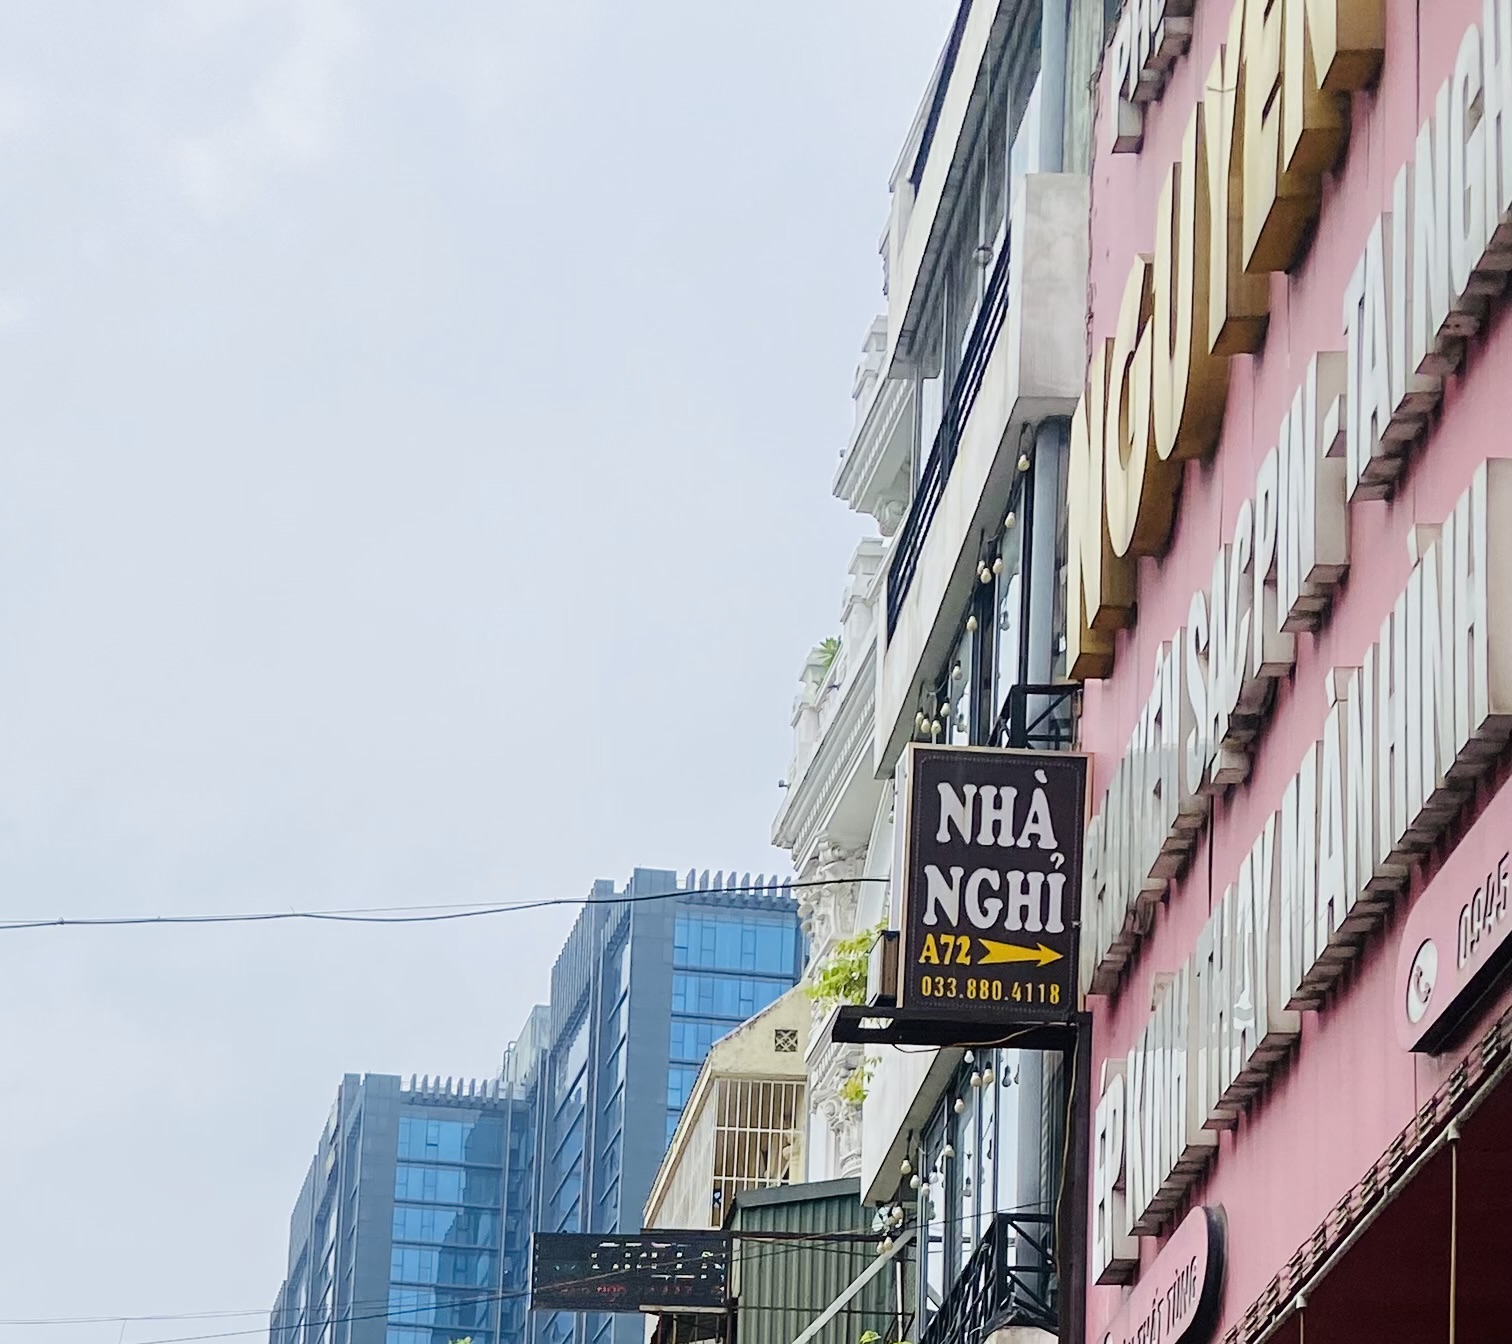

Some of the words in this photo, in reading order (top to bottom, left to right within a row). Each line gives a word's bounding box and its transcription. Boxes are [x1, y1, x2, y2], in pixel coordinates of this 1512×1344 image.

[1253, 352, 1318, 676] PIN
[1344, 161, 1406, 501] TAI
[936, 768, 1058, 849] NHÀ
[1195, 811, 1276, 1131] THAY
[1282, 643, 1374, 1011] MÀN
[1378, 458, 1489, 866] HÌNH
[923, 852, 1066, 934] NGHỈ
[918, 933, 972, 966] A72
[921, 975, 1061, 1005] 033.880.4118
